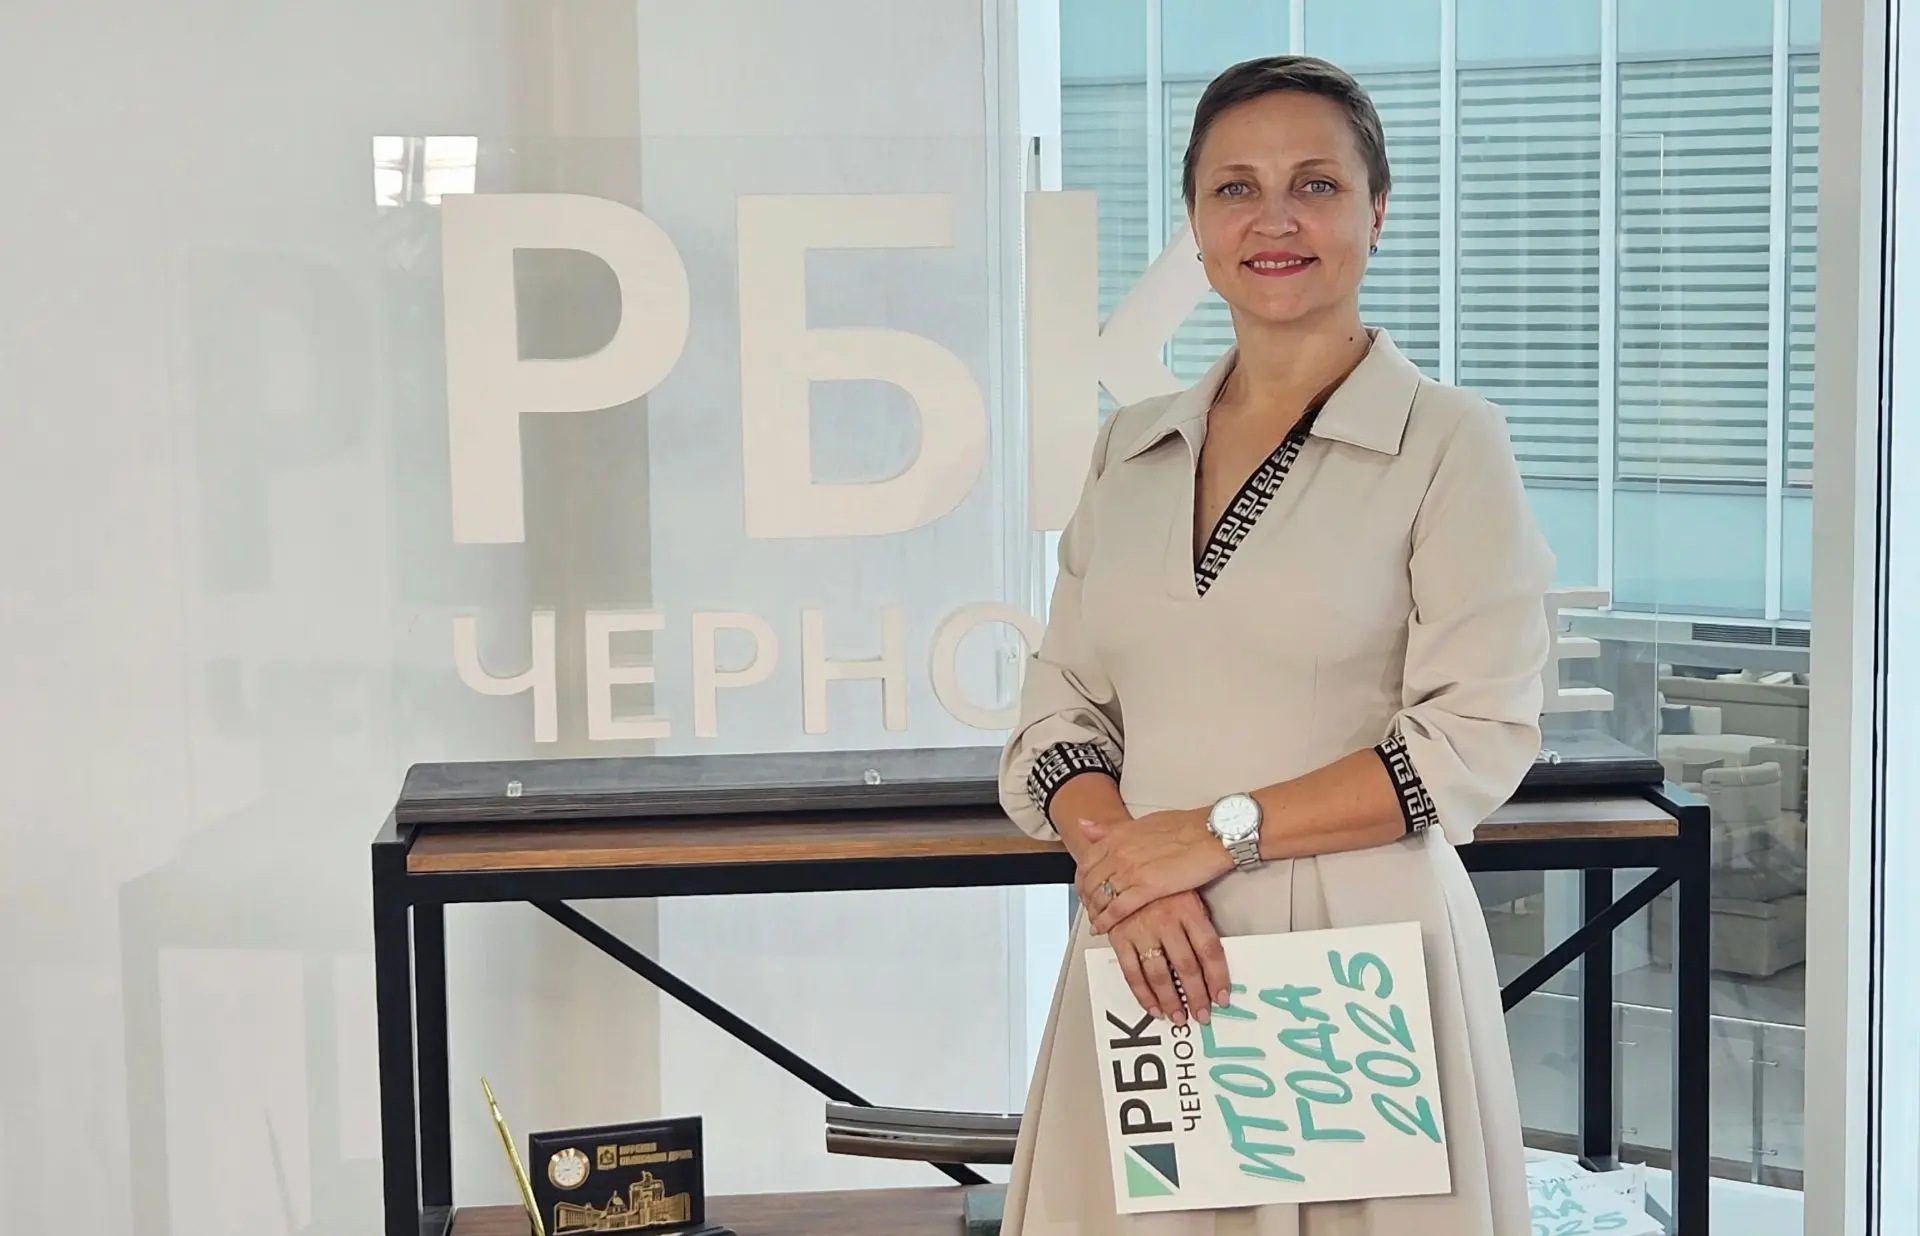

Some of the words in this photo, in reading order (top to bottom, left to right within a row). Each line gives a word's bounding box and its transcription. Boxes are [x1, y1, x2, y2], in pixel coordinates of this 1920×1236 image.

[441, 191, 1211, 544] РБК
[1105, 1009, 1173, 1136] РБК
[1170, 1023, 1203, 1132] ЧЕРНОЗ
[1257, 983, 1366, 1142] ГОДА
[1327, 950, 1442, 1144] 2025
